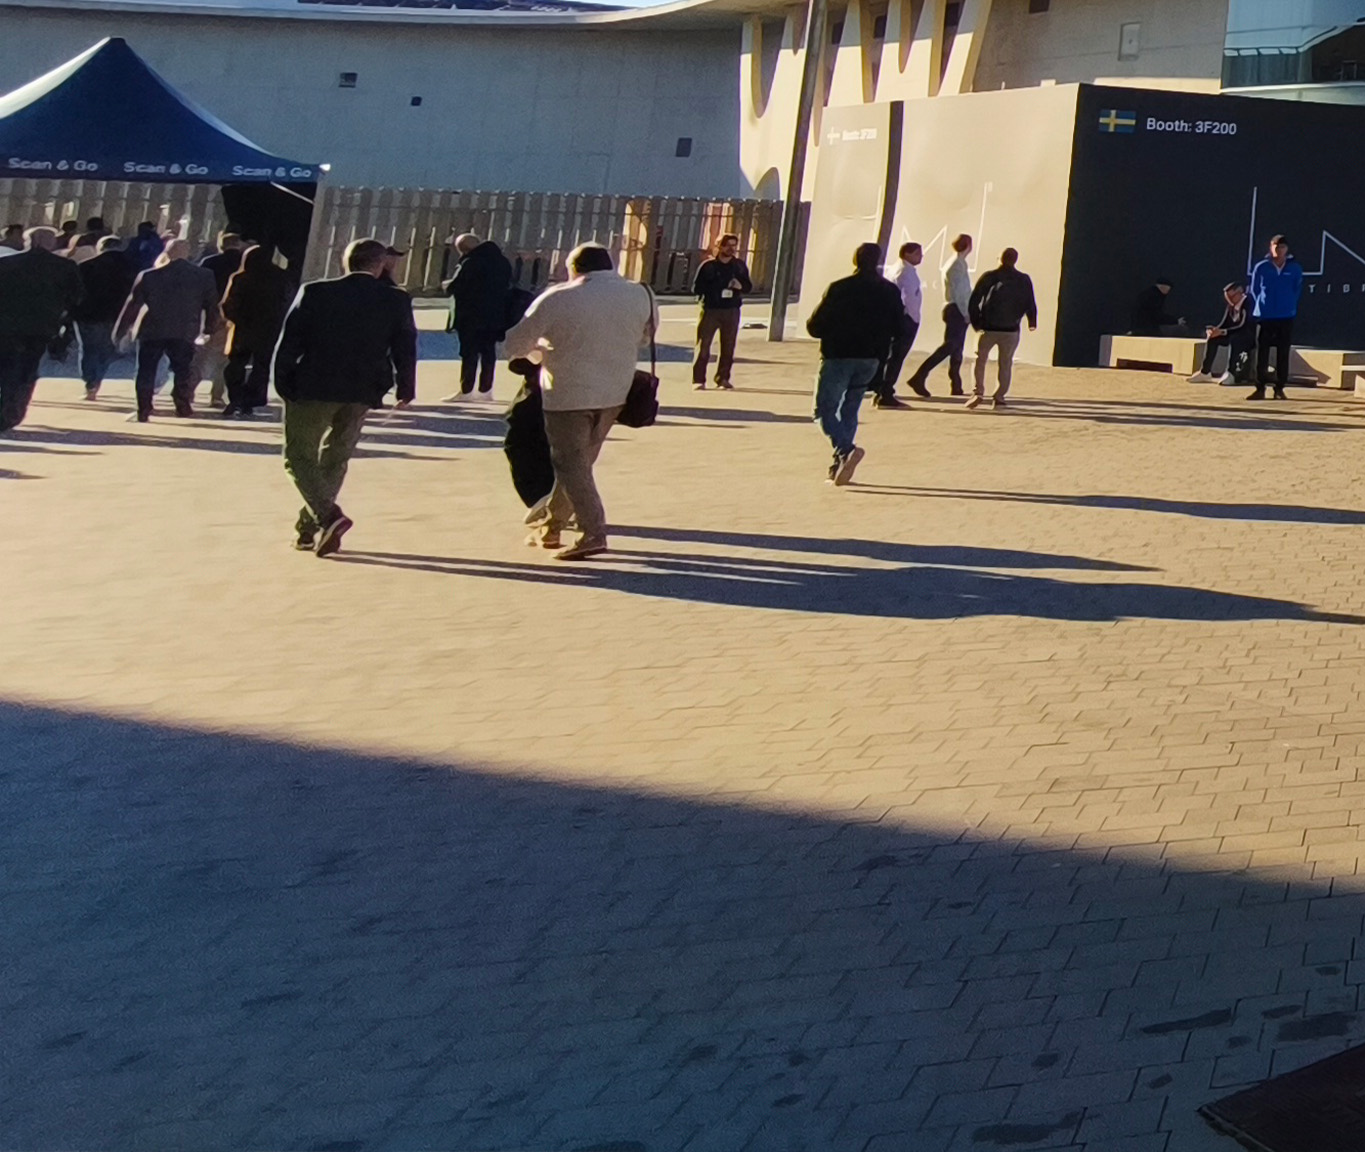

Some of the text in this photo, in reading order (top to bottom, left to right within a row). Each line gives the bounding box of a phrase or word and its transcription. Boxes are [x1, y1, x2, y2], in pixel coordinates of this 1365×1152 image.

[1146, 117, 1237, 135] Booth: 3F200
[8, 157, 52, 170] Scan
[73, 160, 98, 171] Go
[123, 161, 166, 173] Scan
[185, 163, 209, 175] Go
[232, 165, 272, 176] Scan
[290, 167, 312, 178] Go
